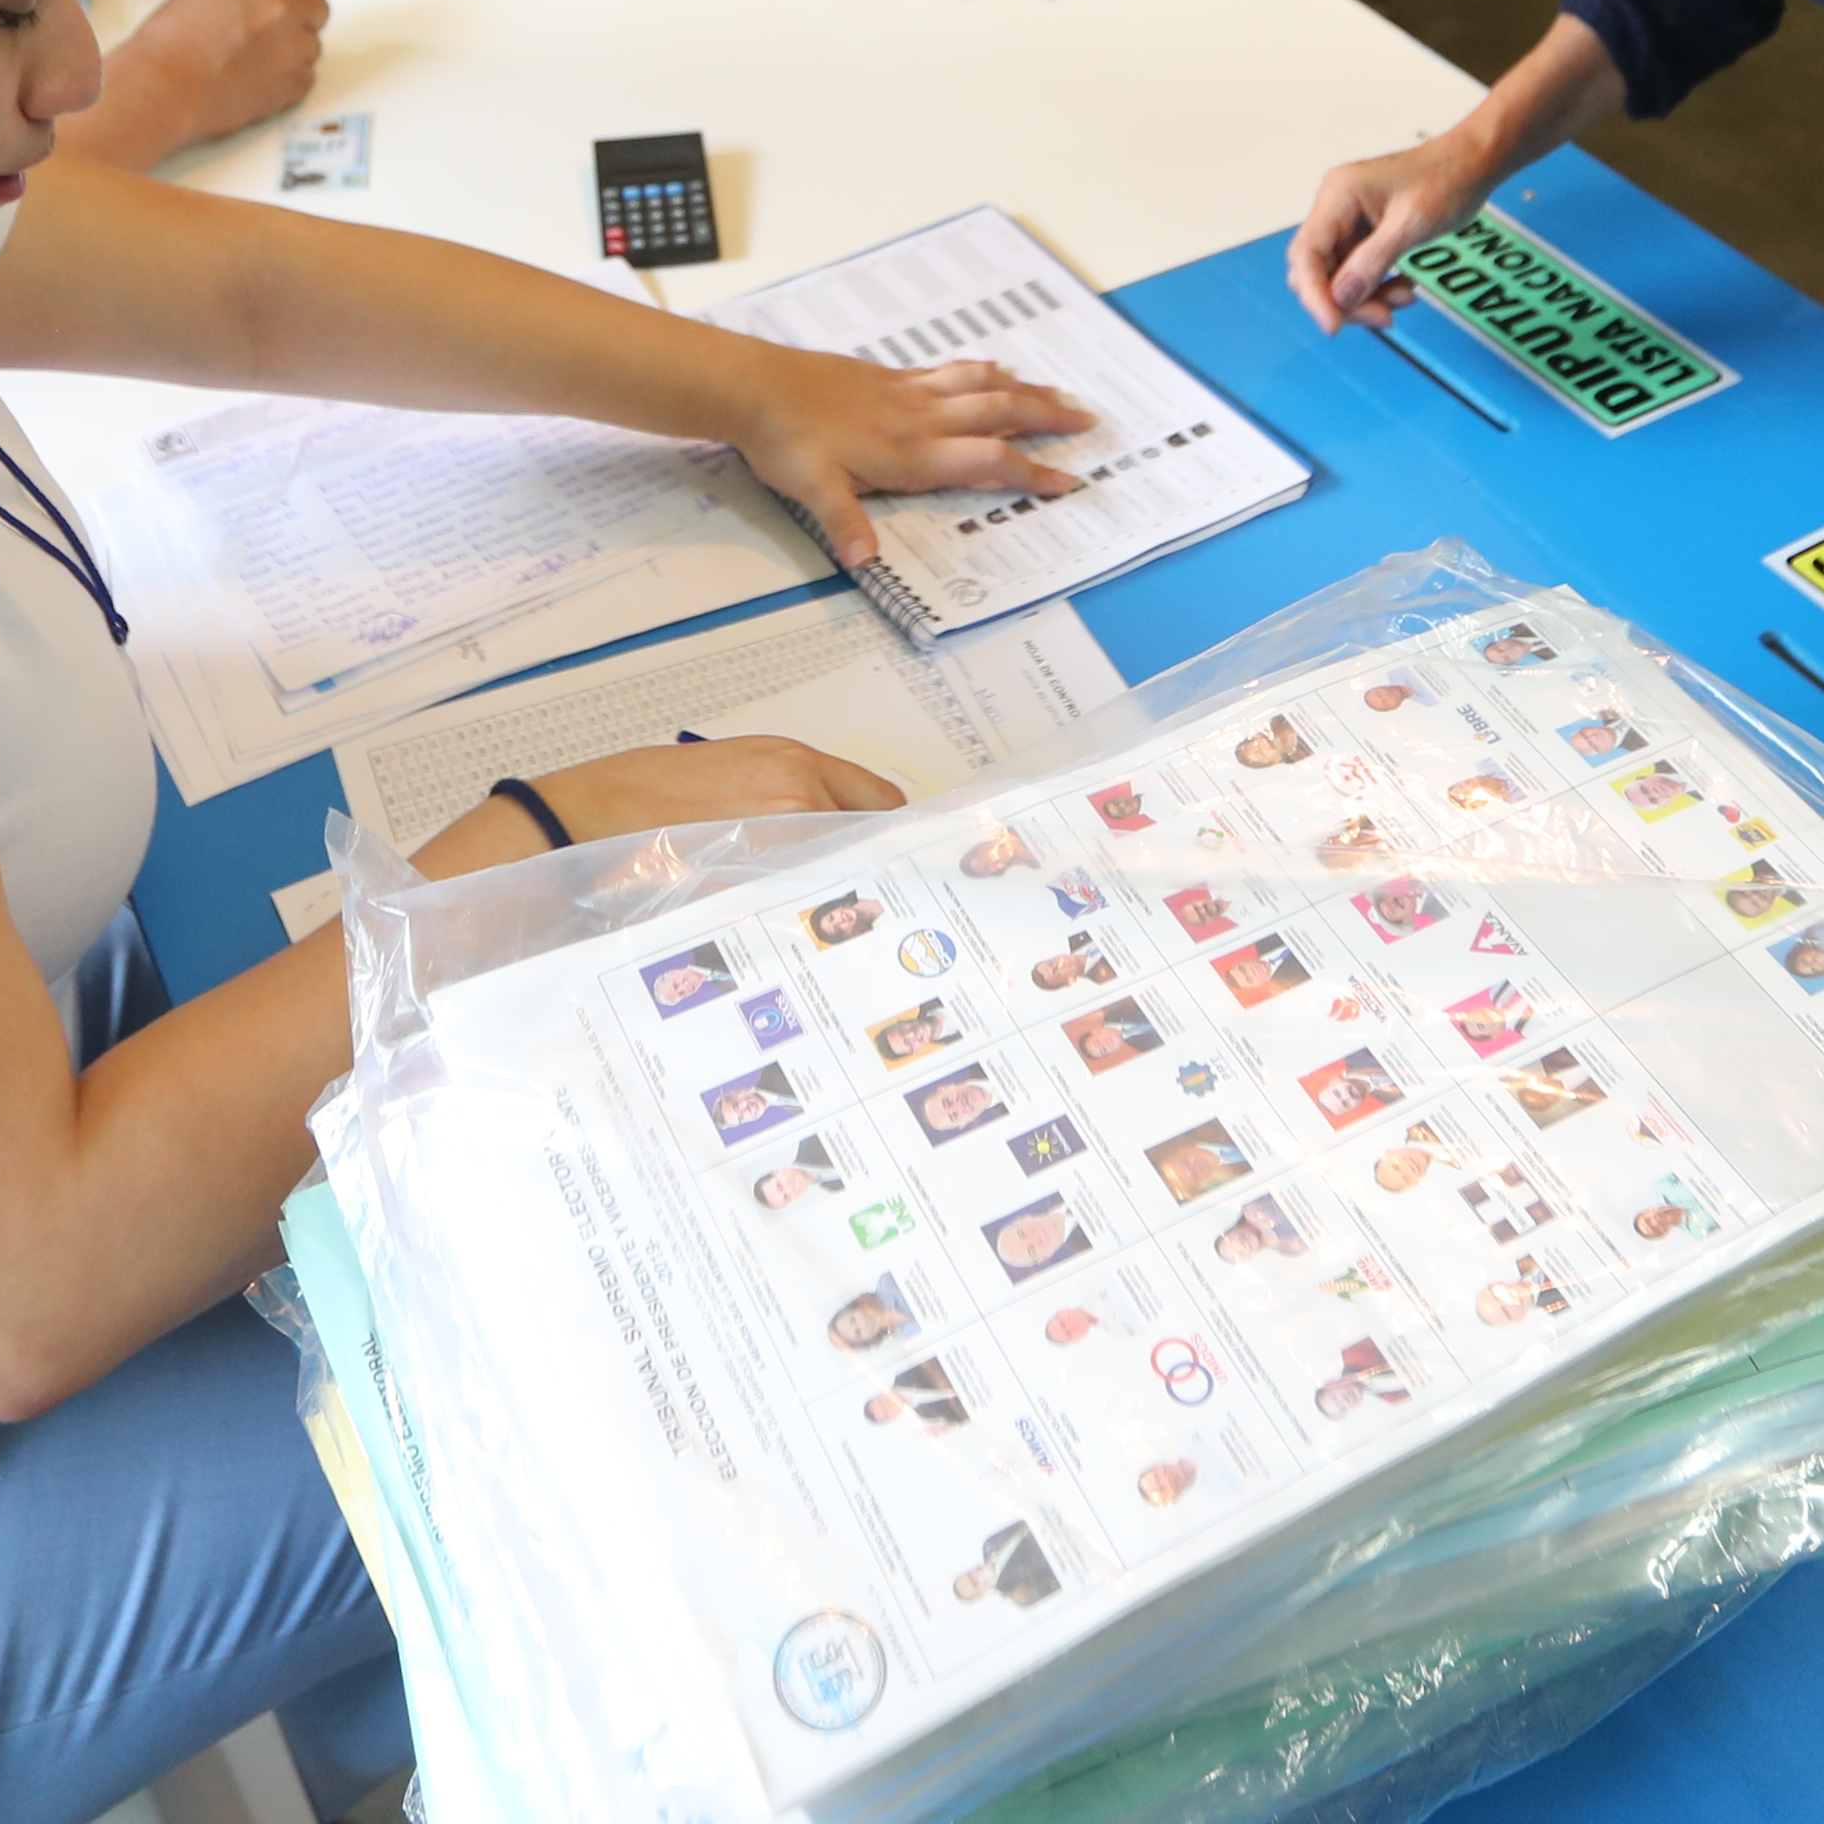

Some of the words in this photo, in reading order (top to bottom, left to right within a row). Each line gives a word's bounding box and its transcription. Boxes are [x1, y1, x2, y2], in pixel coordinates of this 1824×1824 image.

[1450, 216, 1609, 326] NACIONA
[1401, 236, 1657, 416] DIPUTADO
[1588, 315, 1702, 389] LISTA
[1022, 638, 1046, 665] HOJA
[1039, 663, 1055, 679] DE
[1048, 677, 1081, 720] CONTRO
[1453, 701, 1503, 746] LIBRE
[922, 927, 954, 968] CREO
[1481, 908, 1529, 959] AVANZA
[771, 992, 800, 1030] TODOS
[1344, 972, 1389, 1025] VICTORIA
[1208, 1053, 1233, 1081] PPT
[536, 1129, 600, 1242] ELECTOR
[548, 1083, 624, 1225] VICEPRESENTE
[610, 1223, 630, 1240] Y
[883, 1191, 918, 1235] UNE
[584, 1241, 645, 1347] SUPREMO
[616, 1236, 680, 1352] PRESIDENTE
[666, 1348, 694, 1382] DE
[1188, 1329, 1229, 1386] UNIDOS
[628, 1342, 694, 1460] TRIBUNAL
[681, 1382, 739, 1484] ELECCIÓN
